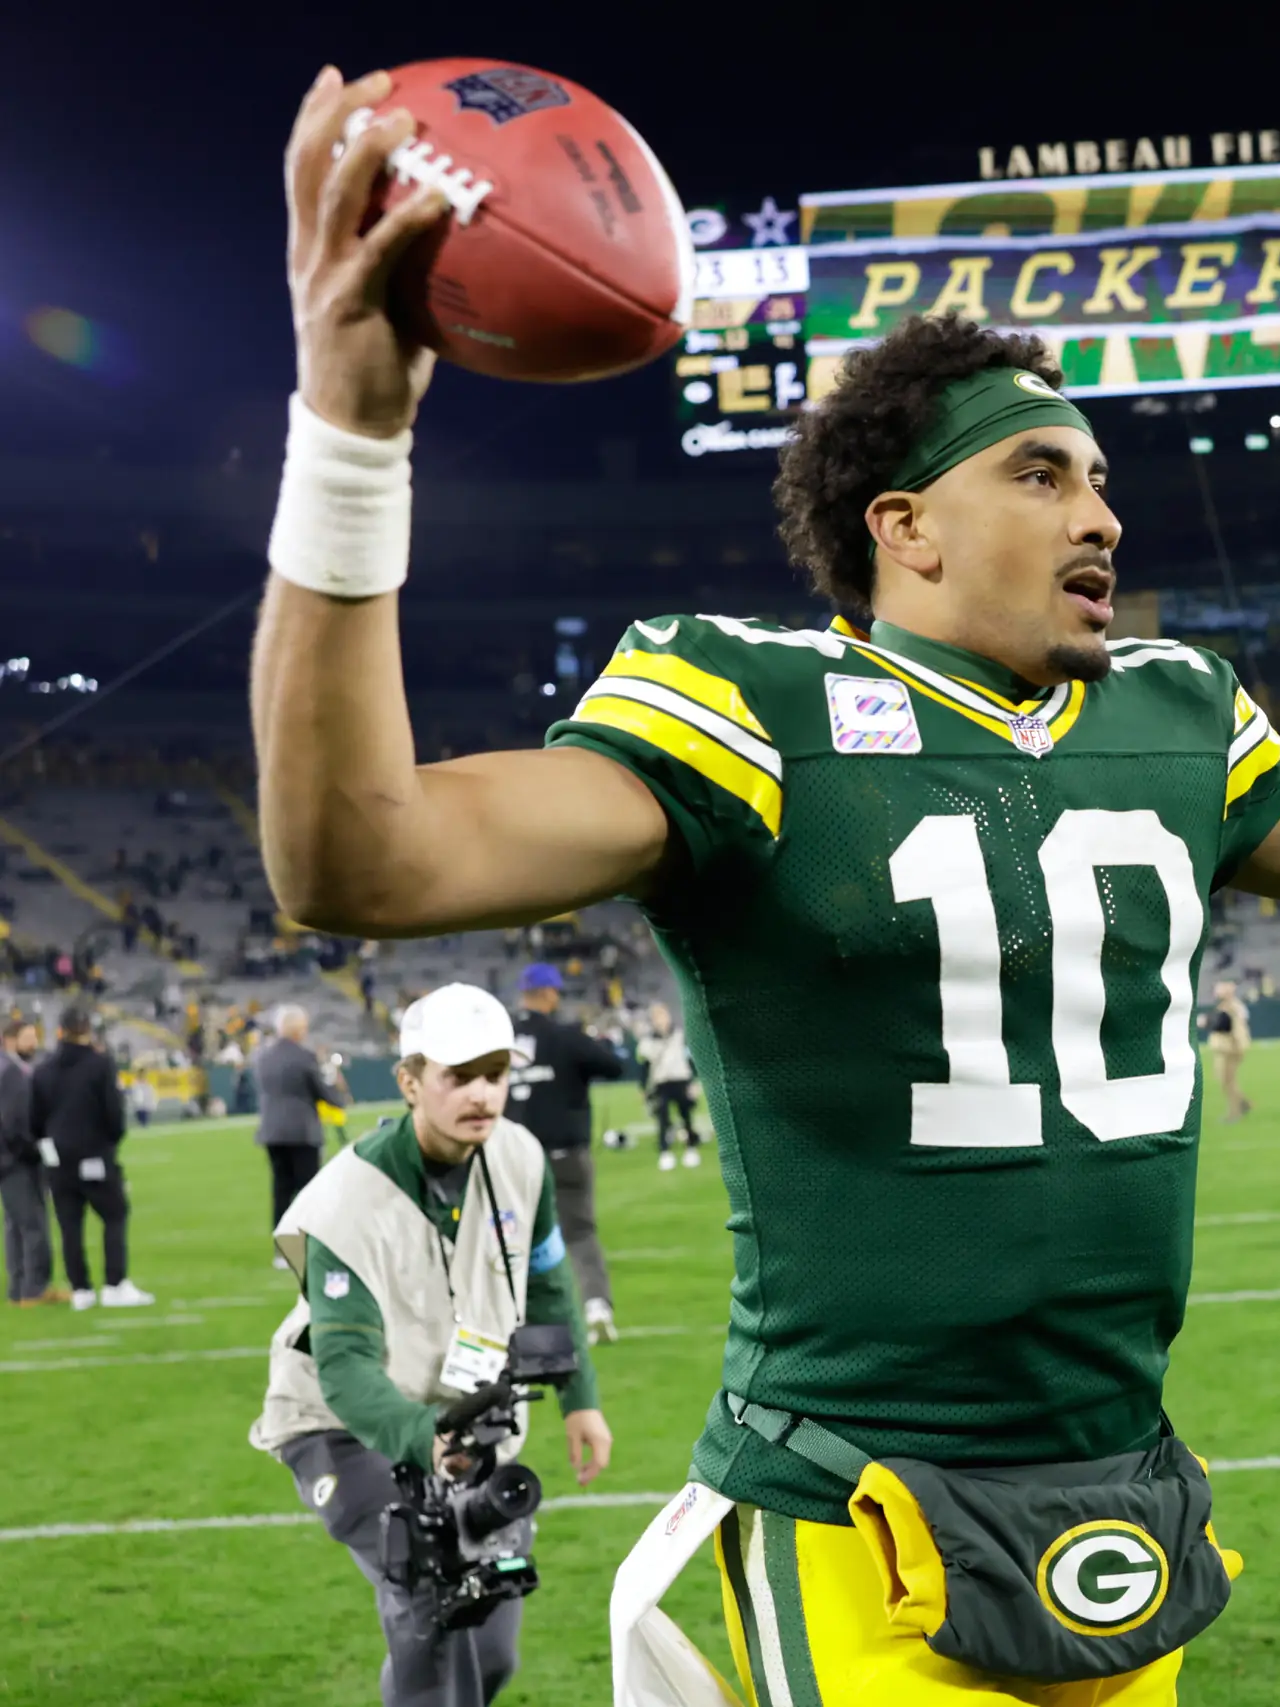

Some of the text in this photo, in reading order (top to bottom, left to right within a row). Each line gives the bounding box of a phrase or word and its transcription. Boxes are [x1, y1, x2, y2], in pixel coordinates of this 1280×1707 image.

[978, 135, 1191, 180] LAMBEAU
[835, 678, 911, 731] C
[1019, 727, 1046, 747] NFL
[889, 808, 1204, 1147] 10
[1050, 1535, 1158, 1623] G
